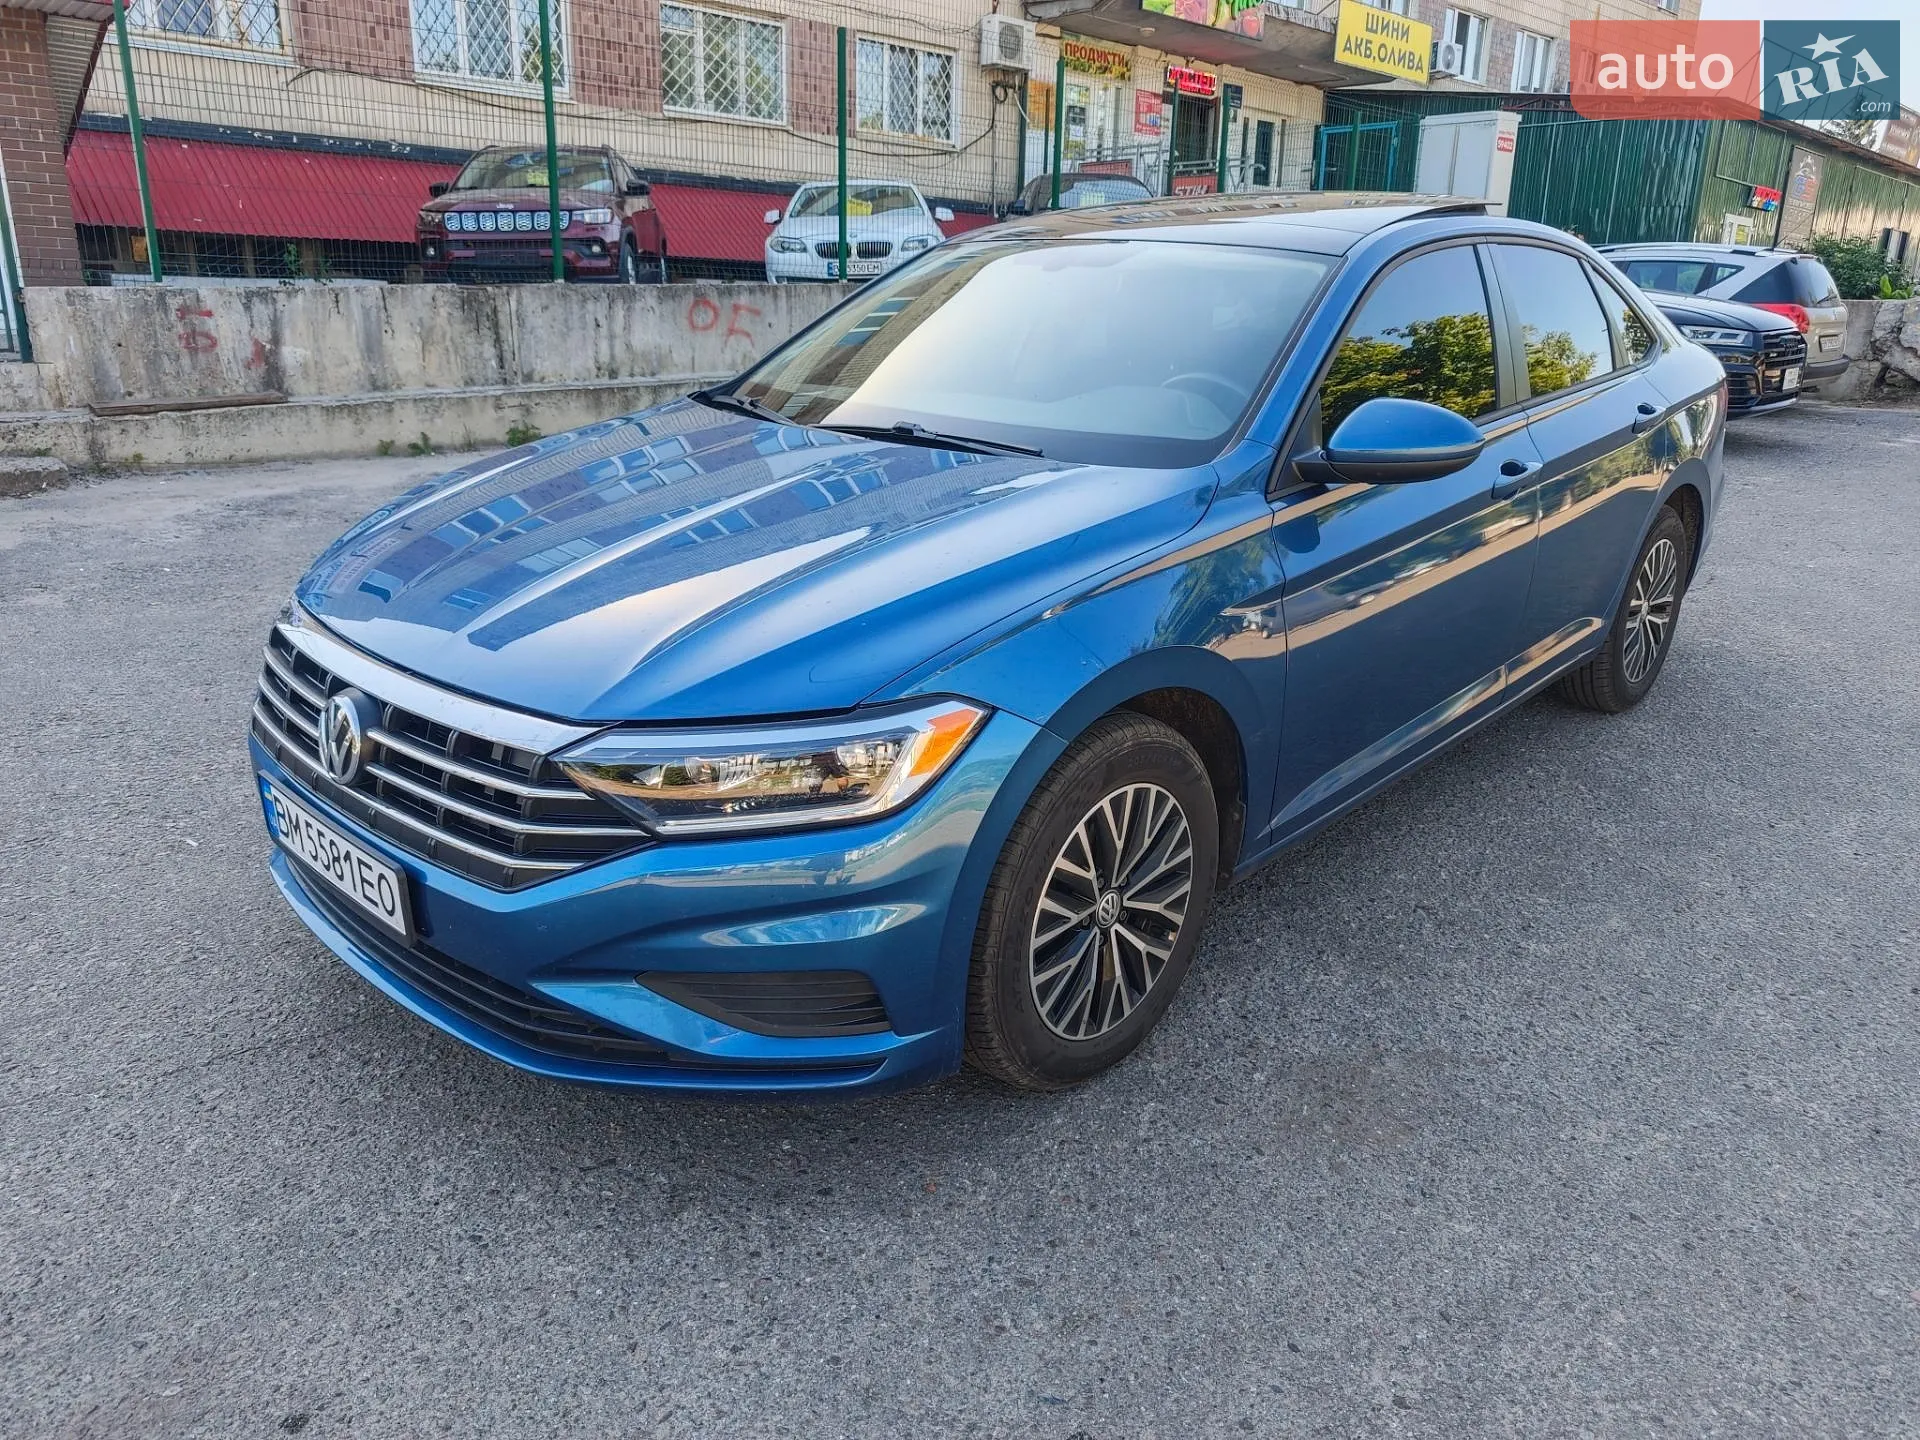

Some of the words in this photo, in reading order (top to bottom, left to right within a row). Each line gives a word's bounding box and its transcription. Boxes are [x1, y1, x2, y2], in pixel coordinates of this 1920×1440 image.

[1366, 12, 1410, 43] ШИНИ
[1065, 42, 1126, 67] ПРОДУКТИ
[1343, 33, 1424, 74] АКБ,ОЛИВА
[273, 794, 305, 853] BM
[304, 819, 356, 892] 5581
